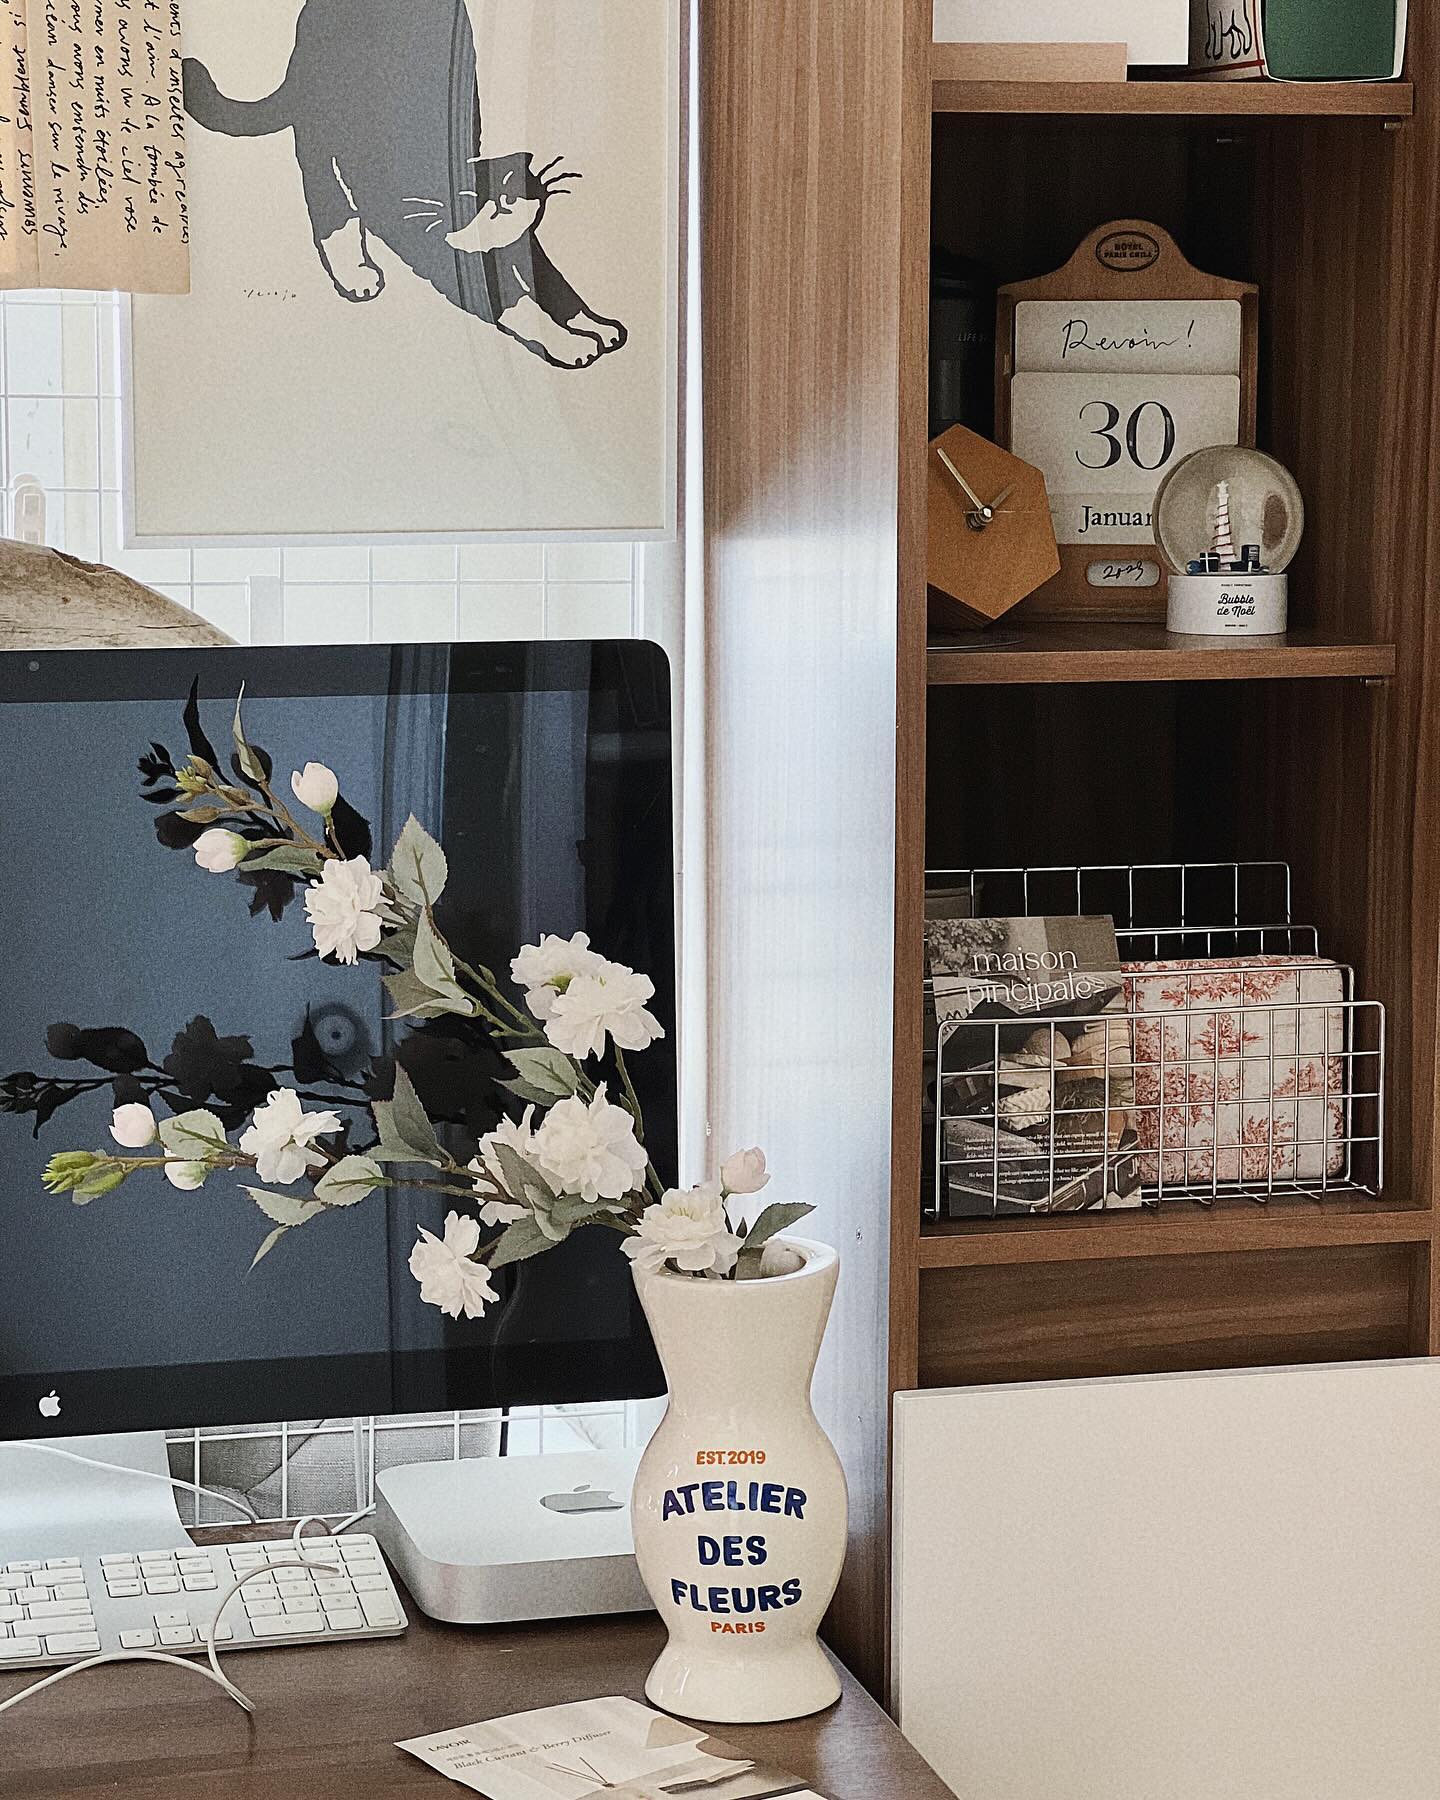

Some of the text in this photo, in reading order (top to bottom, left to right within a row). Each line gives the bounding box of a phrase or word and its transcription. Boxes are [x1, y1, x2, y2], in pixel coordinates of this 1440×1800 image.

[152, 216, 169, 234] de
[1075, 401, 1176, 470] 30
[1077, 505, 1153, 534] Januar
[1216, 605, 1256, 618] de Noël
[1217, 592, 1255, 605] Bubble
[972, 946, 1079, 973] maison
[662, 1480, 808, 1521] ATELIER
[697, 1535, 768, 1566] DES
[671, 1577, 803, 1613] FLEURS
[710, 1621, 766, 1633] PARIS
[453, 1758, 483, 1769] Black
[542, 1740, 571, 1751] Berry
[572, 1730, 613, 1744] Diffuser
